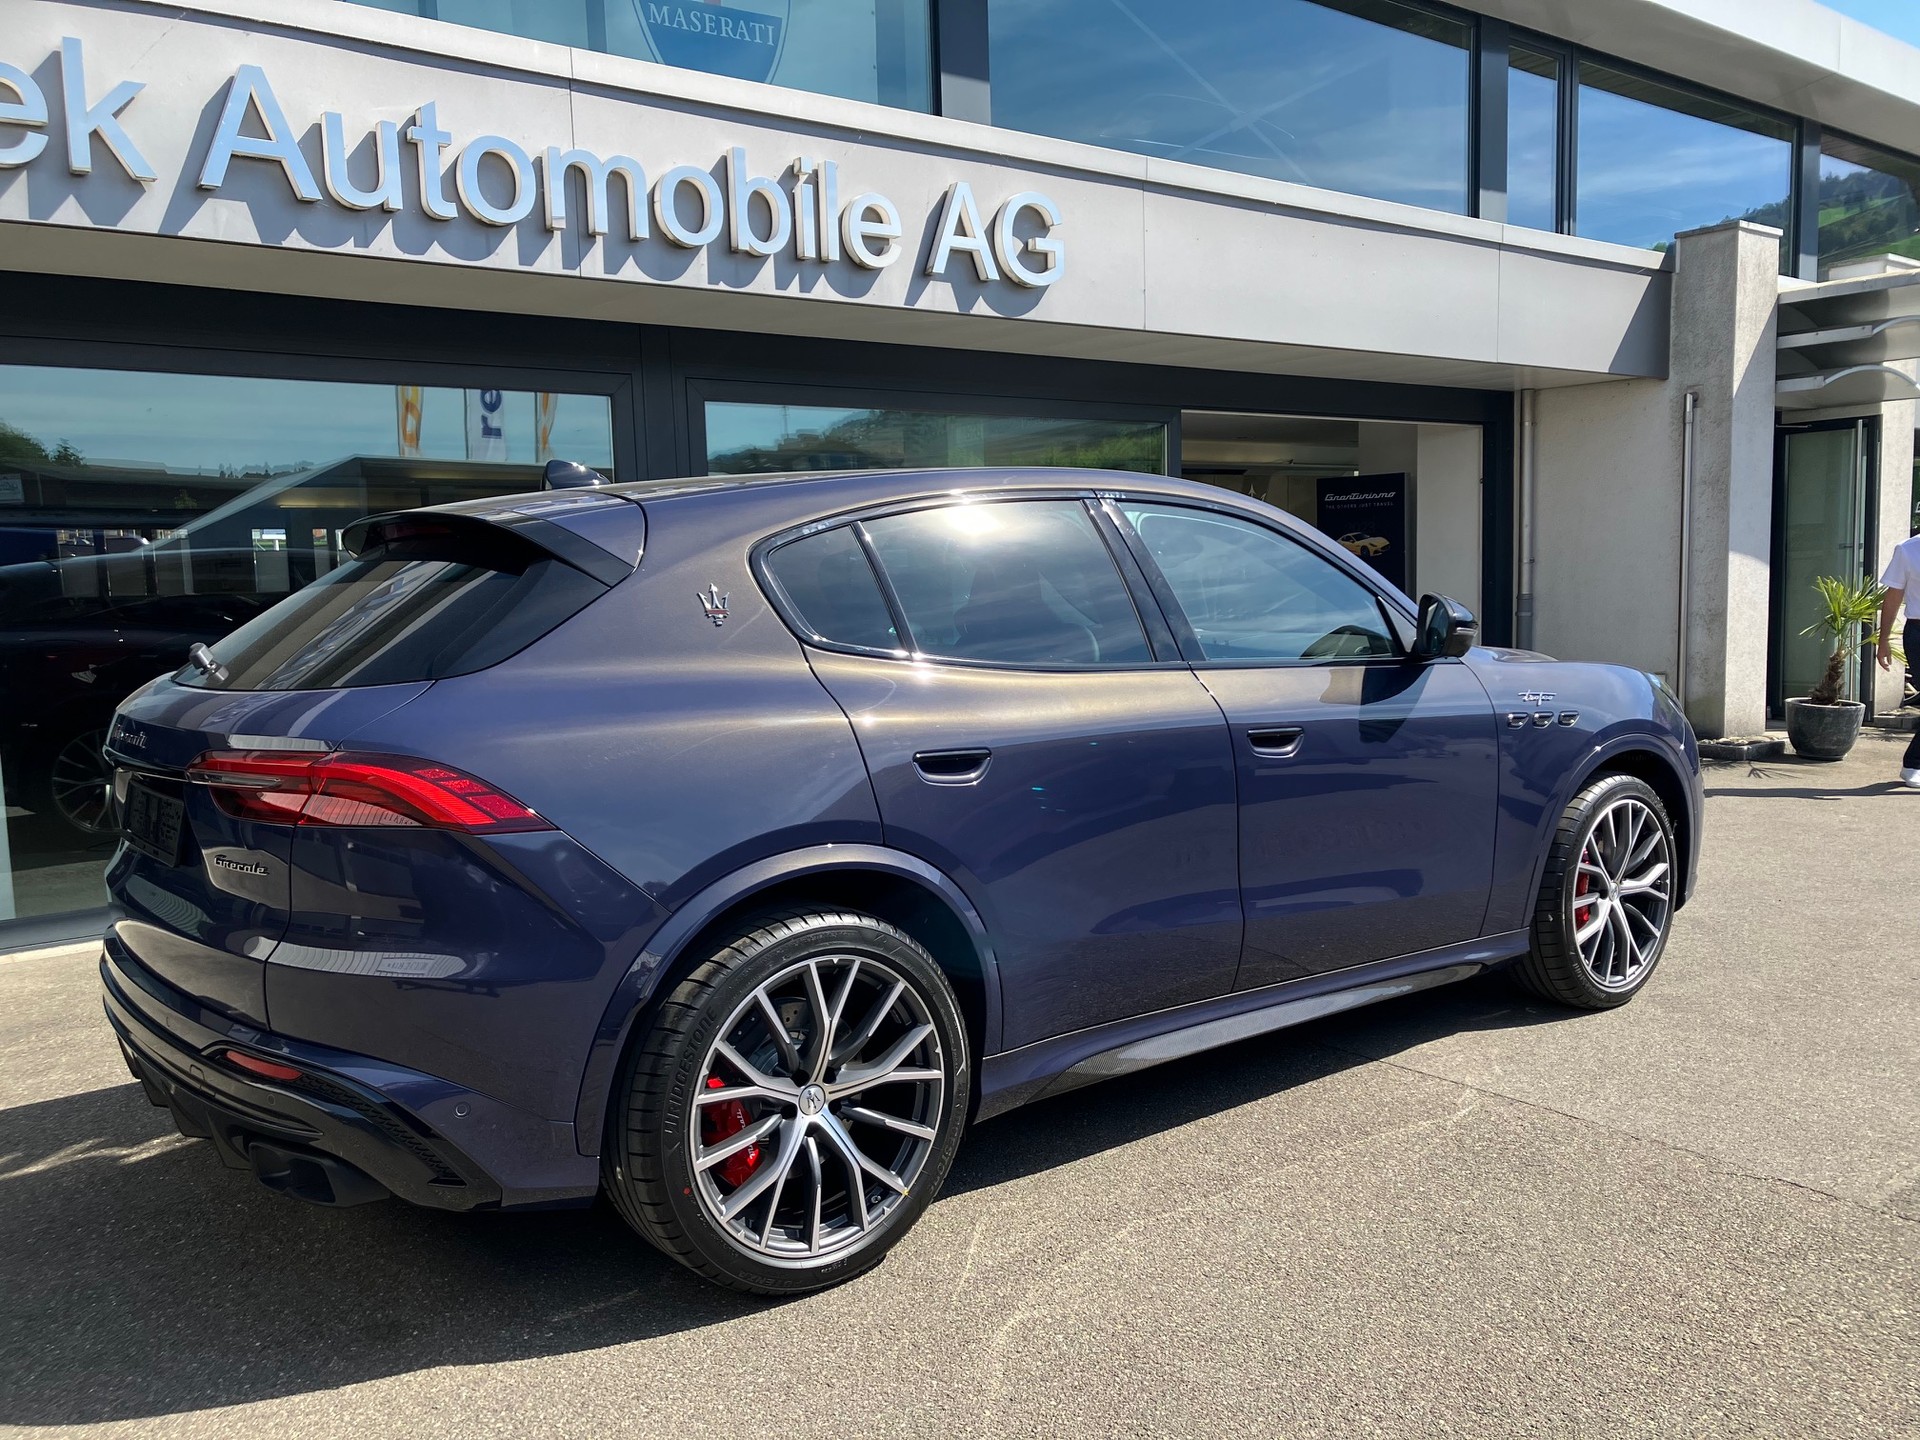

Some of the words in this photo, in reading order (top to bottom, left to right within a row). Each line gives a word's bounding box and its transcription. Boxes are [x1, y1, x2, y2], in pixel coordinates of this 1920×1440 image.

[648, 2, 775, 46] MASERATI
[197, 64, 901, 270] Automobile
[925, 182, 1065, 288] AG
[213, 854, 269, 876] Grecale
